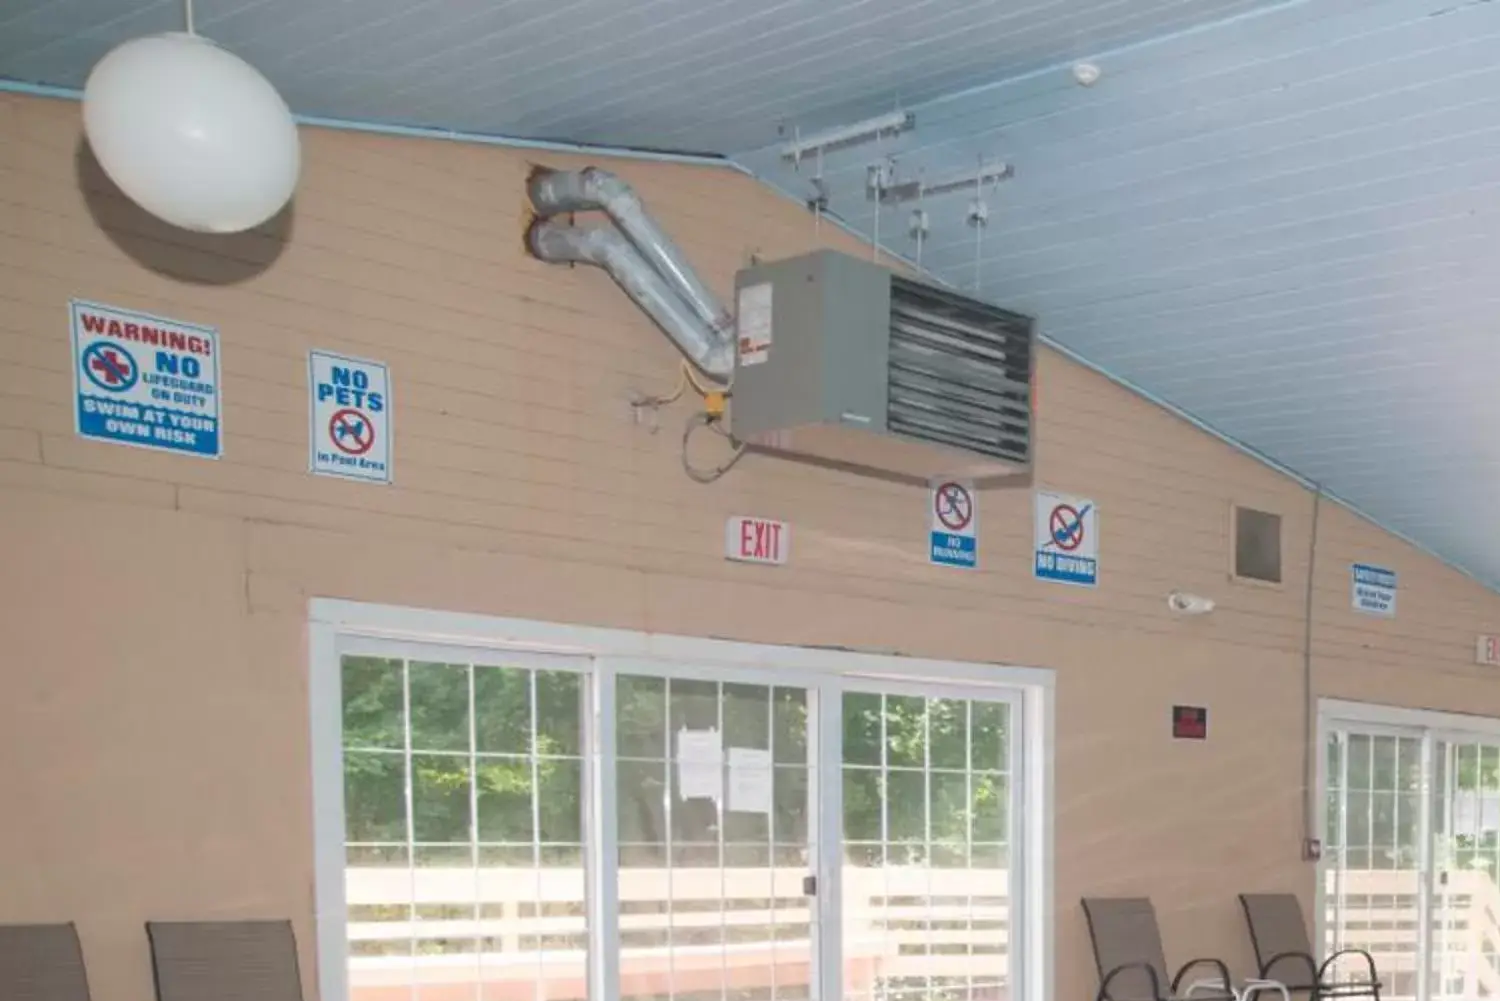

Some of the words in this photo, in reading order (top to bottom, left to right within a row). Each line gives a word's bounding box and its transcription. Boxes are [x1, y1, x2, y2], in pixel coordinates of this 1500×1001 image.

[80, 313, 210, 356] WARNING!
[156, 351, 200, 378] NO
[332, 366, 369, 390] NO
[142, 372, 213, 394] LIFEGUARD
[151, 387, 170, 401] ON
[173, 391, 206, 408] DUTY
[318, 383, 384, 413] PETS
[83, 399, 139, 420] SWIM
[143, 409, 165, 423] AT
[169, 413, 214, 432] YOUR
[105, 418, 150, 438] OWN
[154, 426, 196, 446] RISK
[741, 519, 782, 561] EXIT
[1038, 551, 1055, 571] NO
